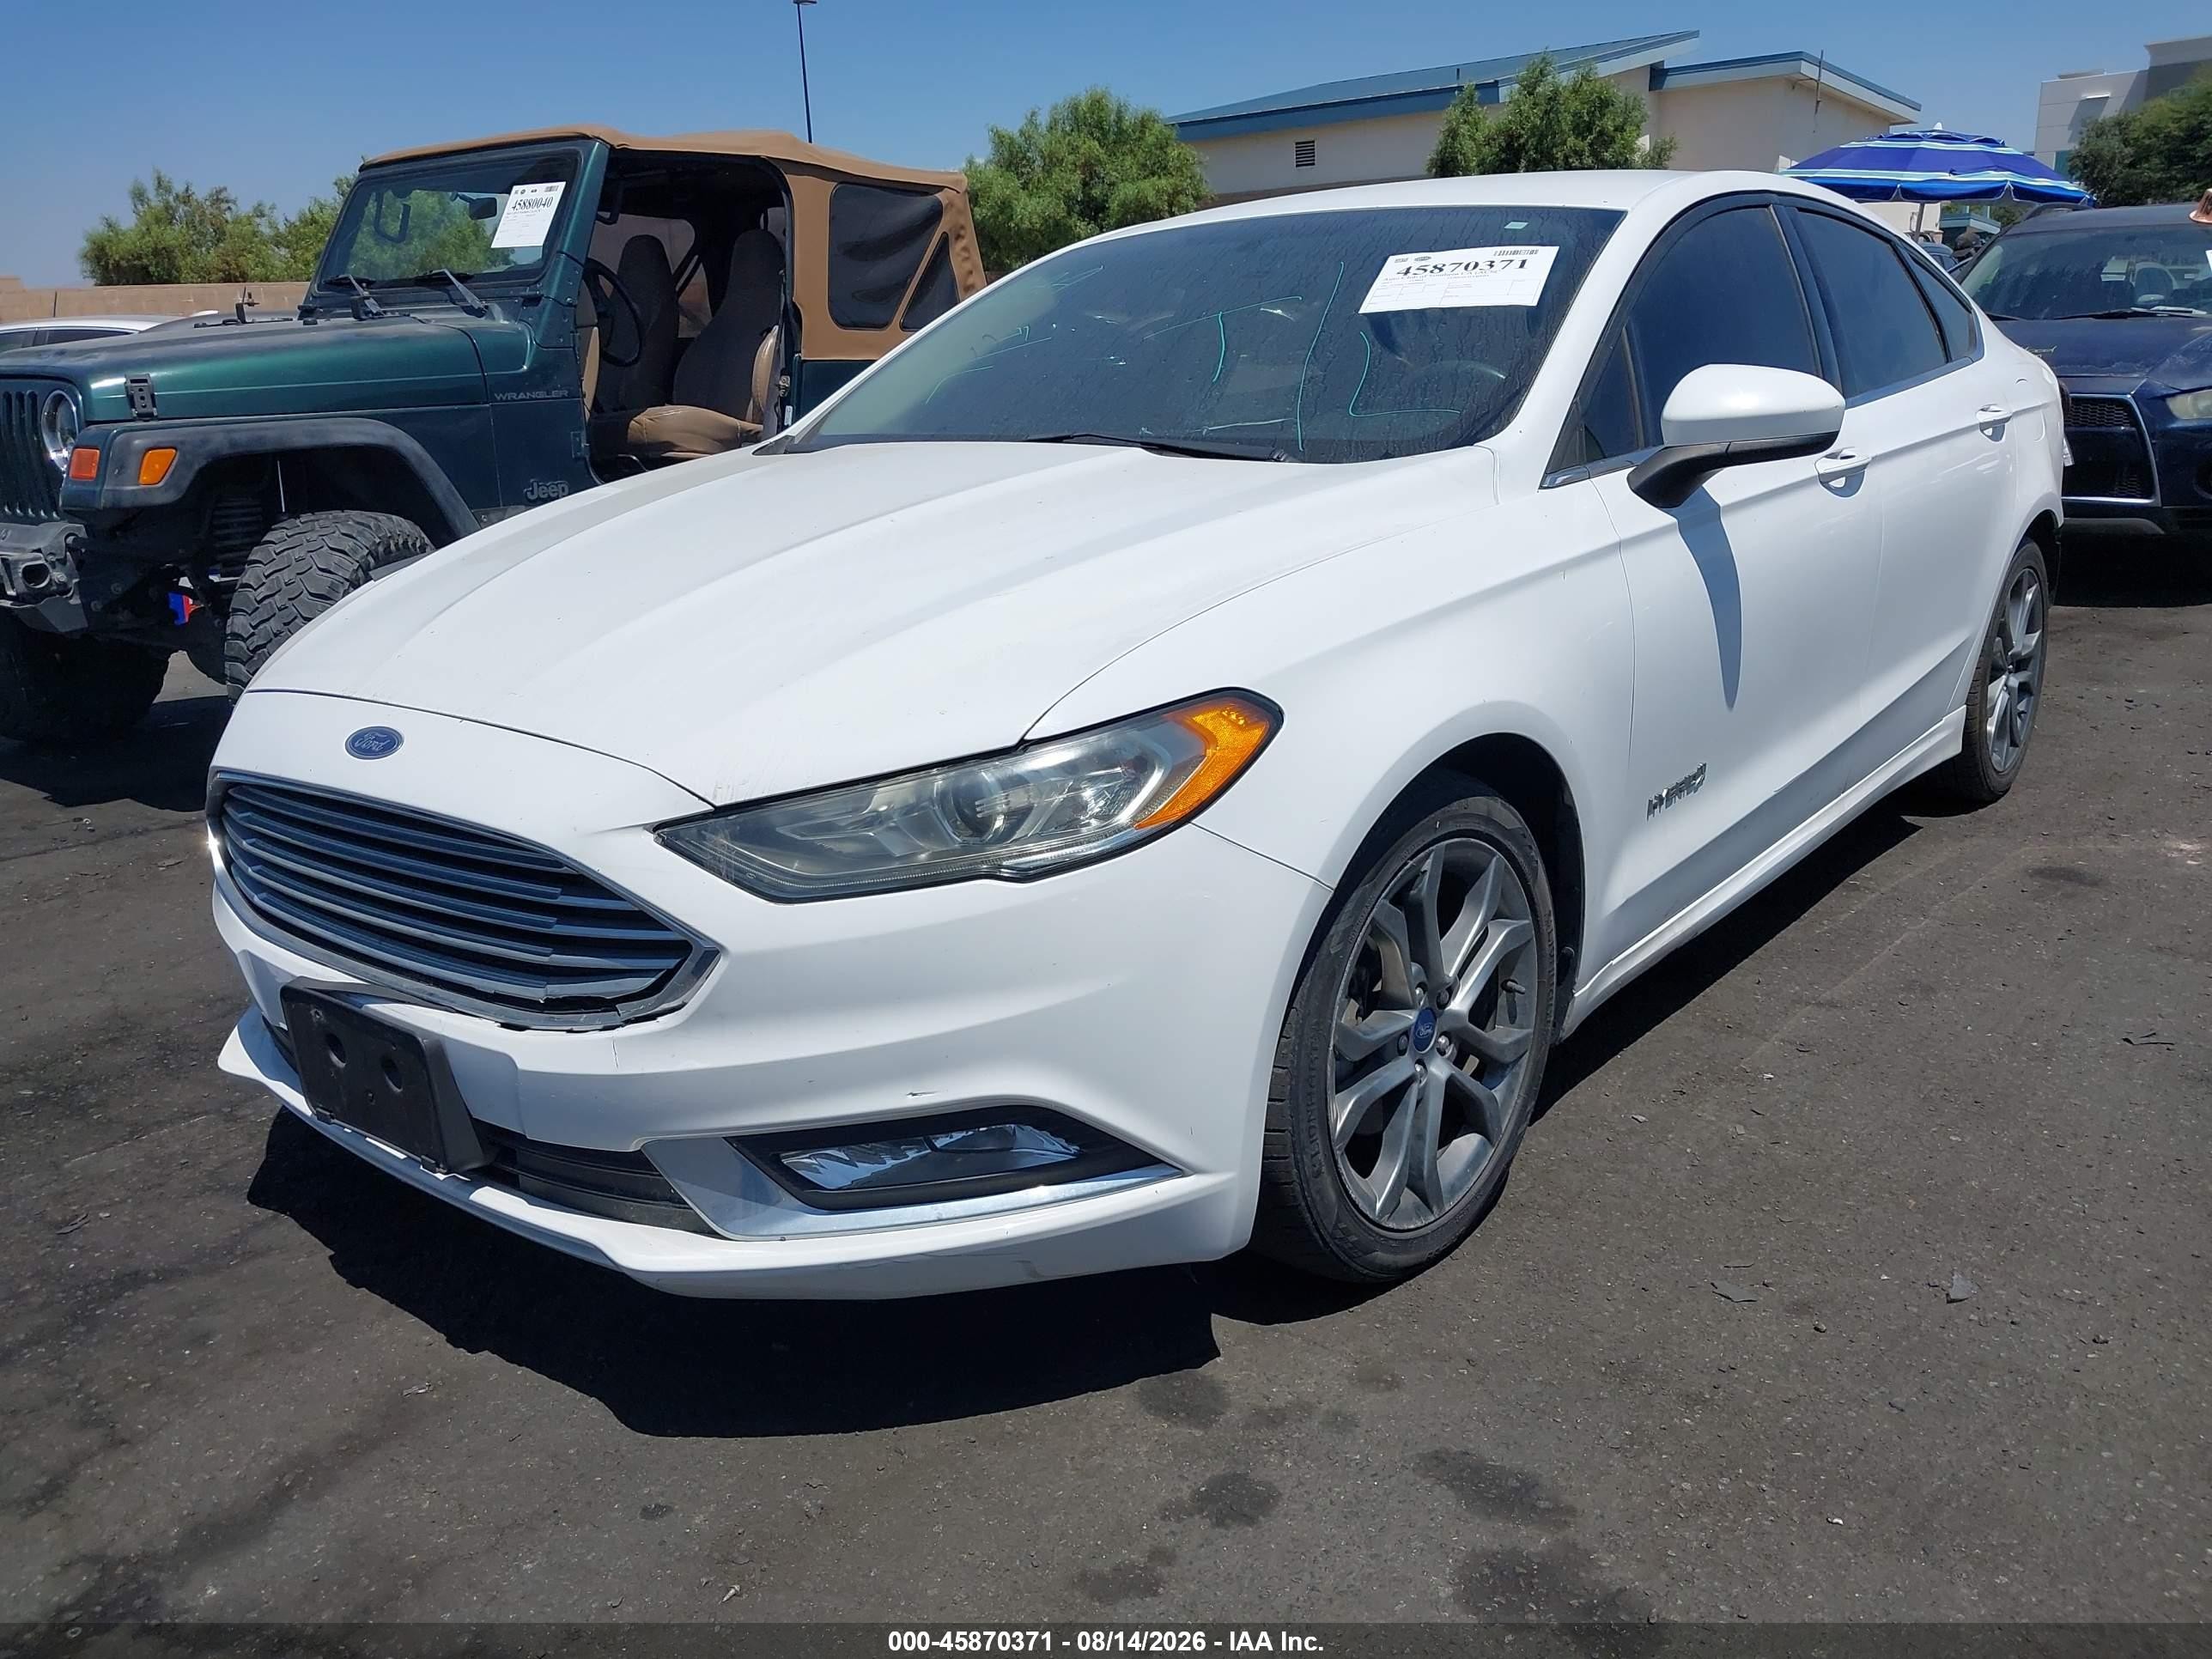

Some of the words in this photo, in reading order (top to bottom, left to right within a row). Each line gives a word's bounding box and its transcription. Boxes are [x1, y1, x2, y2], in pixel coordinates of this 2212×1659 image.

[511, 197, 554, 211] 45880040
[1396, 258, 1528, 276] 45870371
[494, 390, 568, 401] WRANGLER
[524, 478, 569, 500] Jeep
[353, 731, 392, 751] Ford
[1646, 762, 1707, 822] HYBRID
